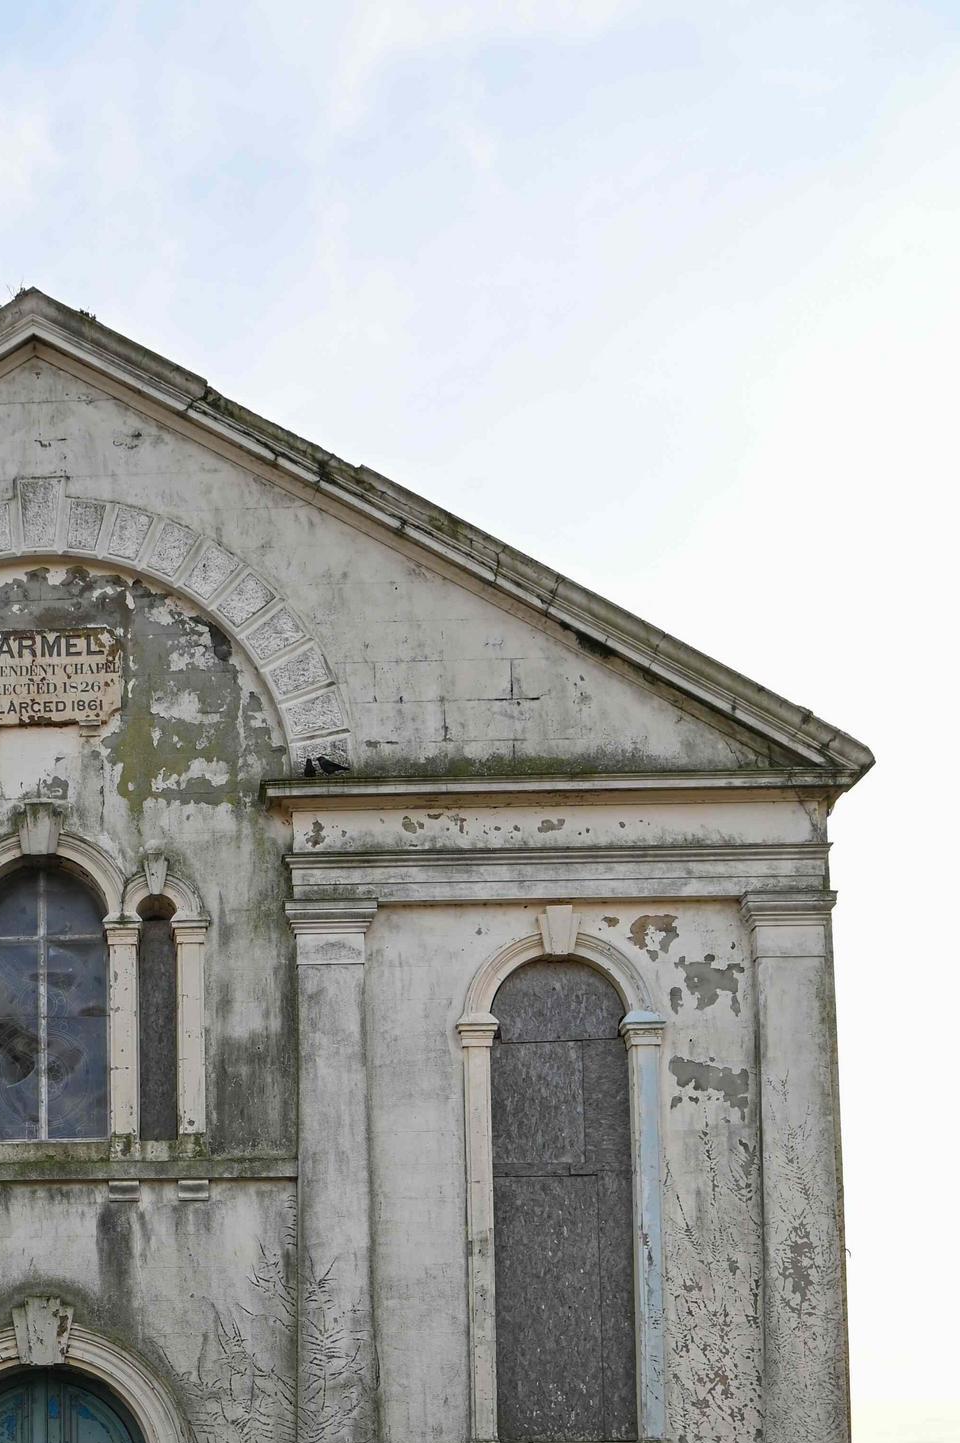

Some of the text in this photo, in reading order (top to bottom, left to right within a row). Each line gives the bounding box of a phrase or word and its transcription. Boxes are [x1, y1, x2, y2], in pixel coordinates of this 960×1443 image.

[63, 662, 119, 678] CHAPEL
[62, 680, 101, 694] 1826
[71, 699, 103, 712] 1861
